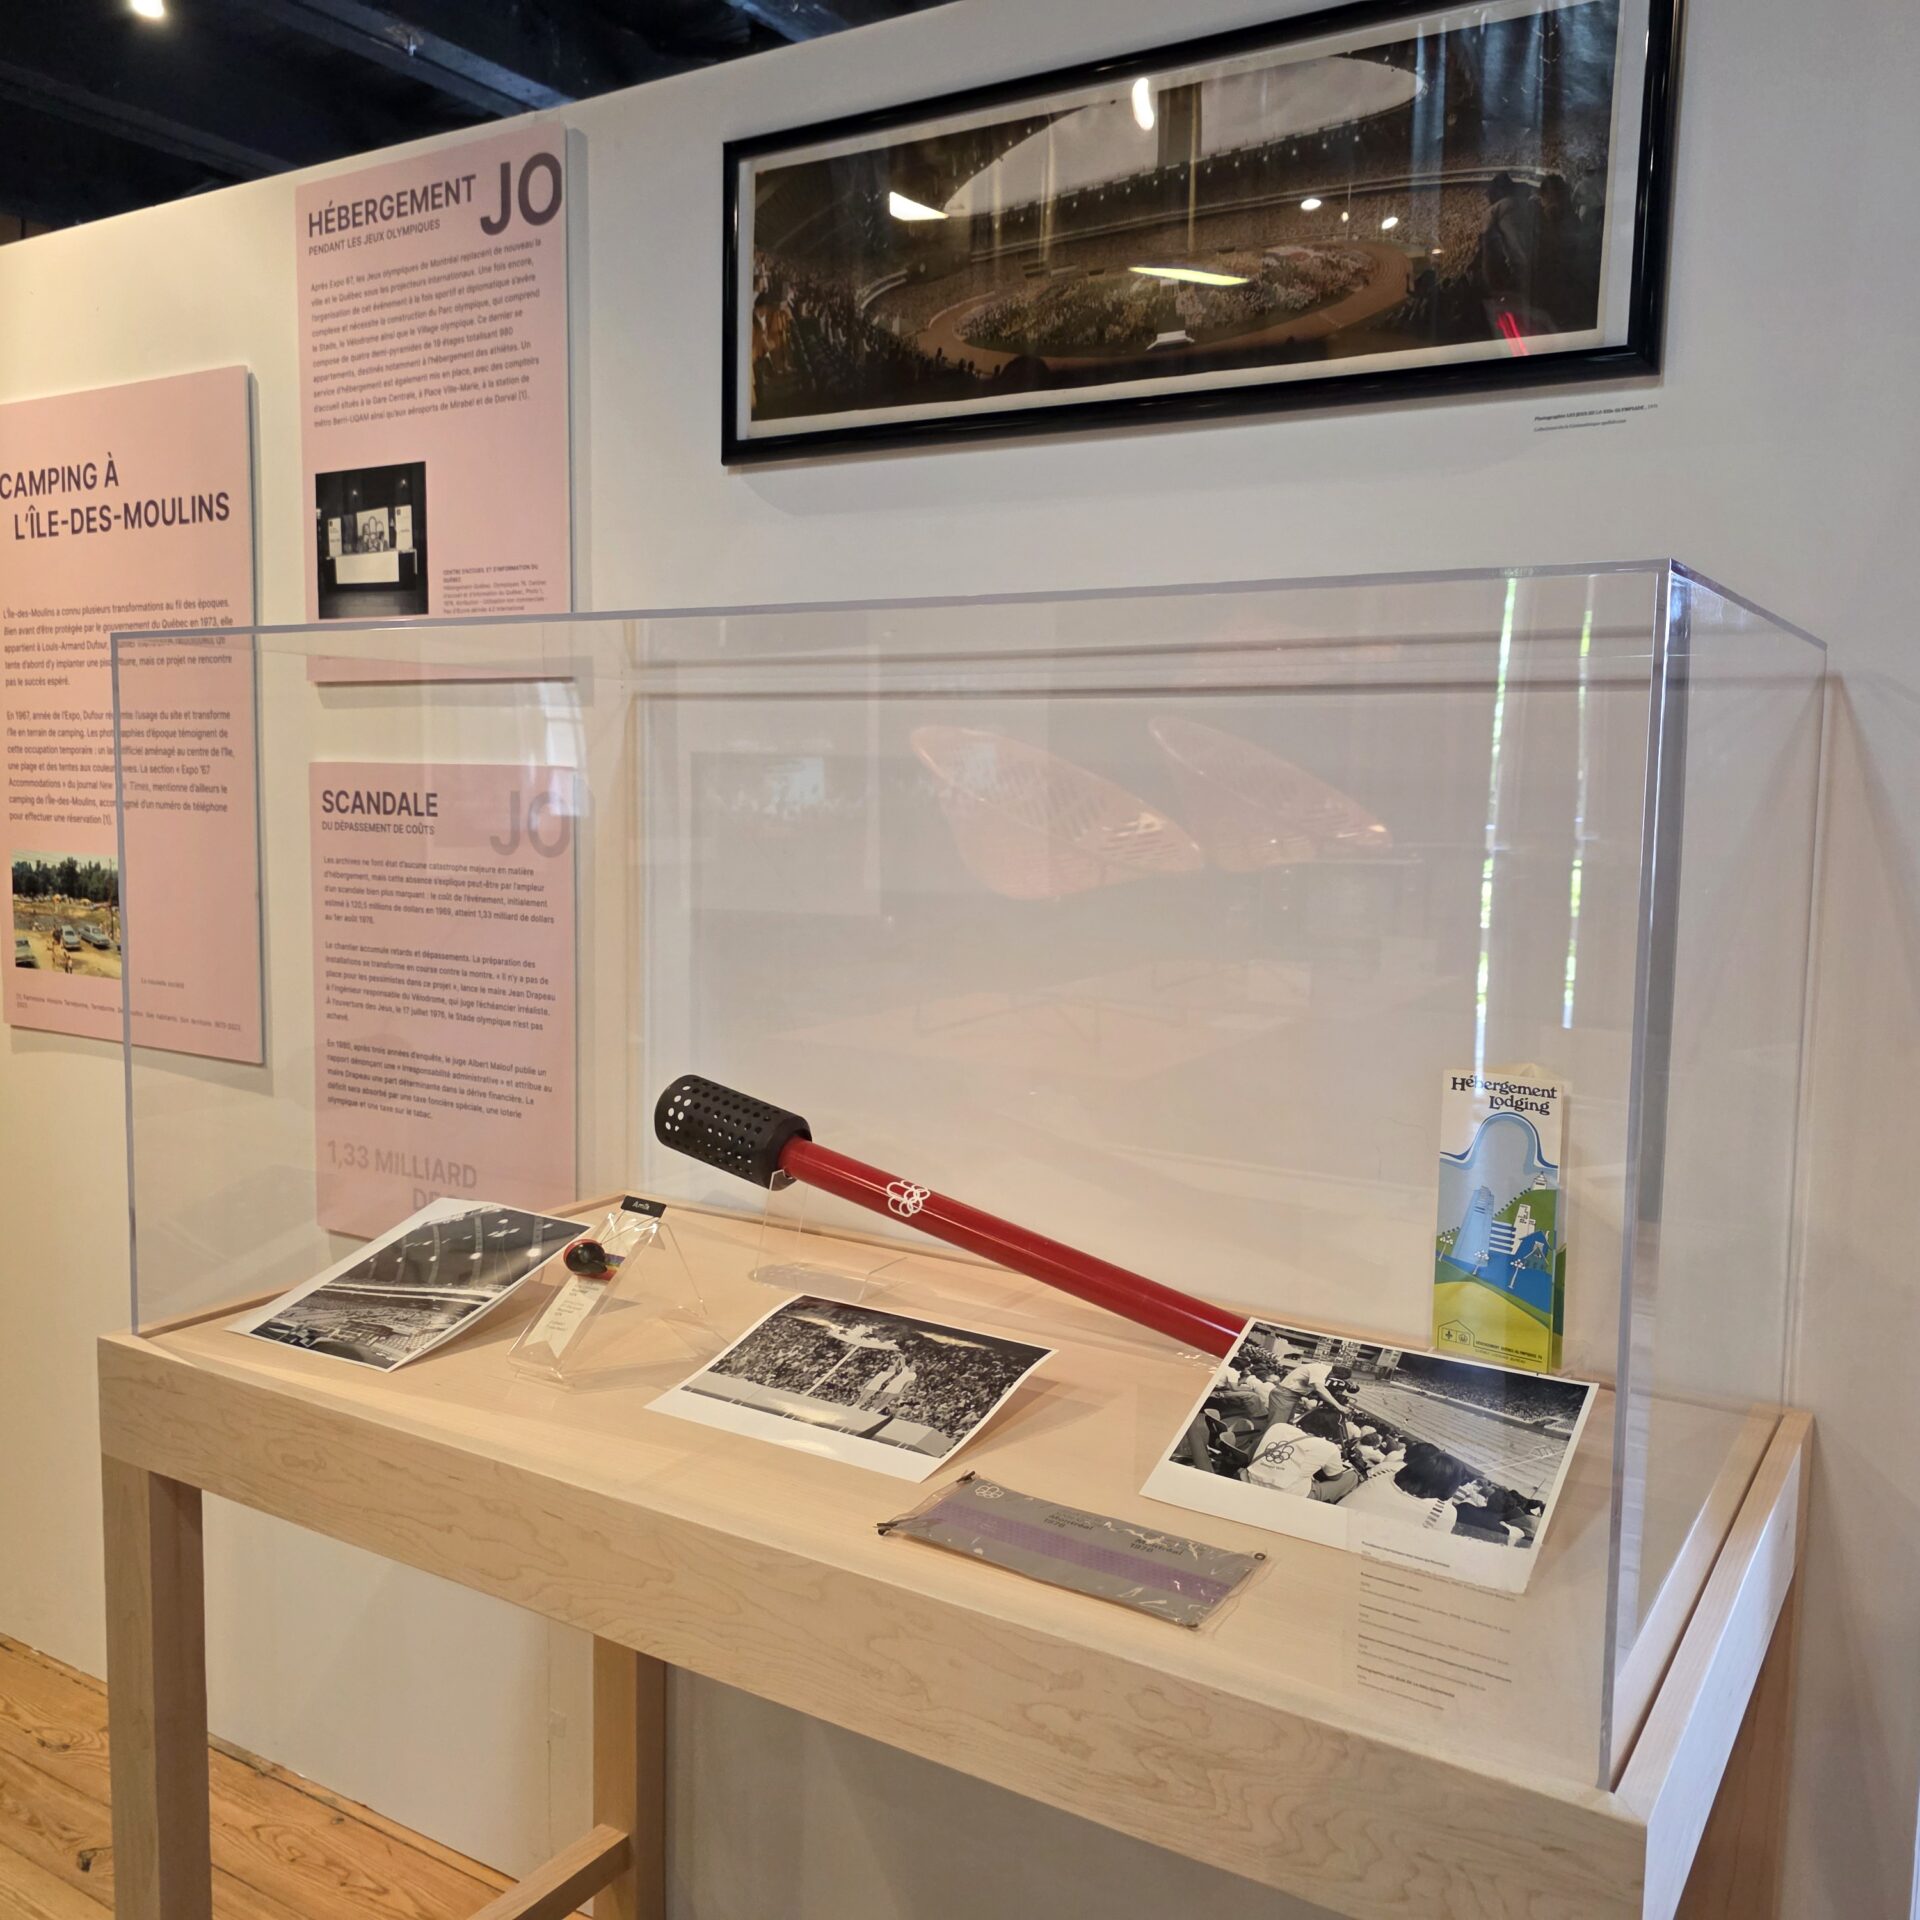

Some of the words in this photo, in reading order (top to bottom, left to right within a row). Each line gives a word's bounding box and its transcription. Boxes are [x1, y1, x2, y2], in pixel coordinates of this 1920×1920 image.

[308, 174, 476, 238] HÉBERGEMENT
[480, 152, 563, 236] JO
[309, 238, 346, 256] PENDANT
[347, 234, 362, 248] LES
[363, 230, 384, 246] JEUX
[387, 219, 440, 240] OLYMPIQUES
[0, 462, 97, 500] CAMPING
[104, 452, 119, 488] À
[14, 492, 230, 541] L'ÎLE-DES-MOULINS
[322, 789, 438, 817] SCANDALE
[490, 790, 571, 858] JO
[322, 821, 333, 831] DU
[334, 820, 391, 834] DÉPASSEMENT
[394, 823, 404, 833] DE
[406, 821, 435, 835] COÛTS
[1451, 1075, 1558, 1099] Hébergement
[1489, 1095, 1550, 1115] Lodging
[327, 1139, 369, 1169] 1,33
[375, 1149, 477, 1189] MILLIARD
